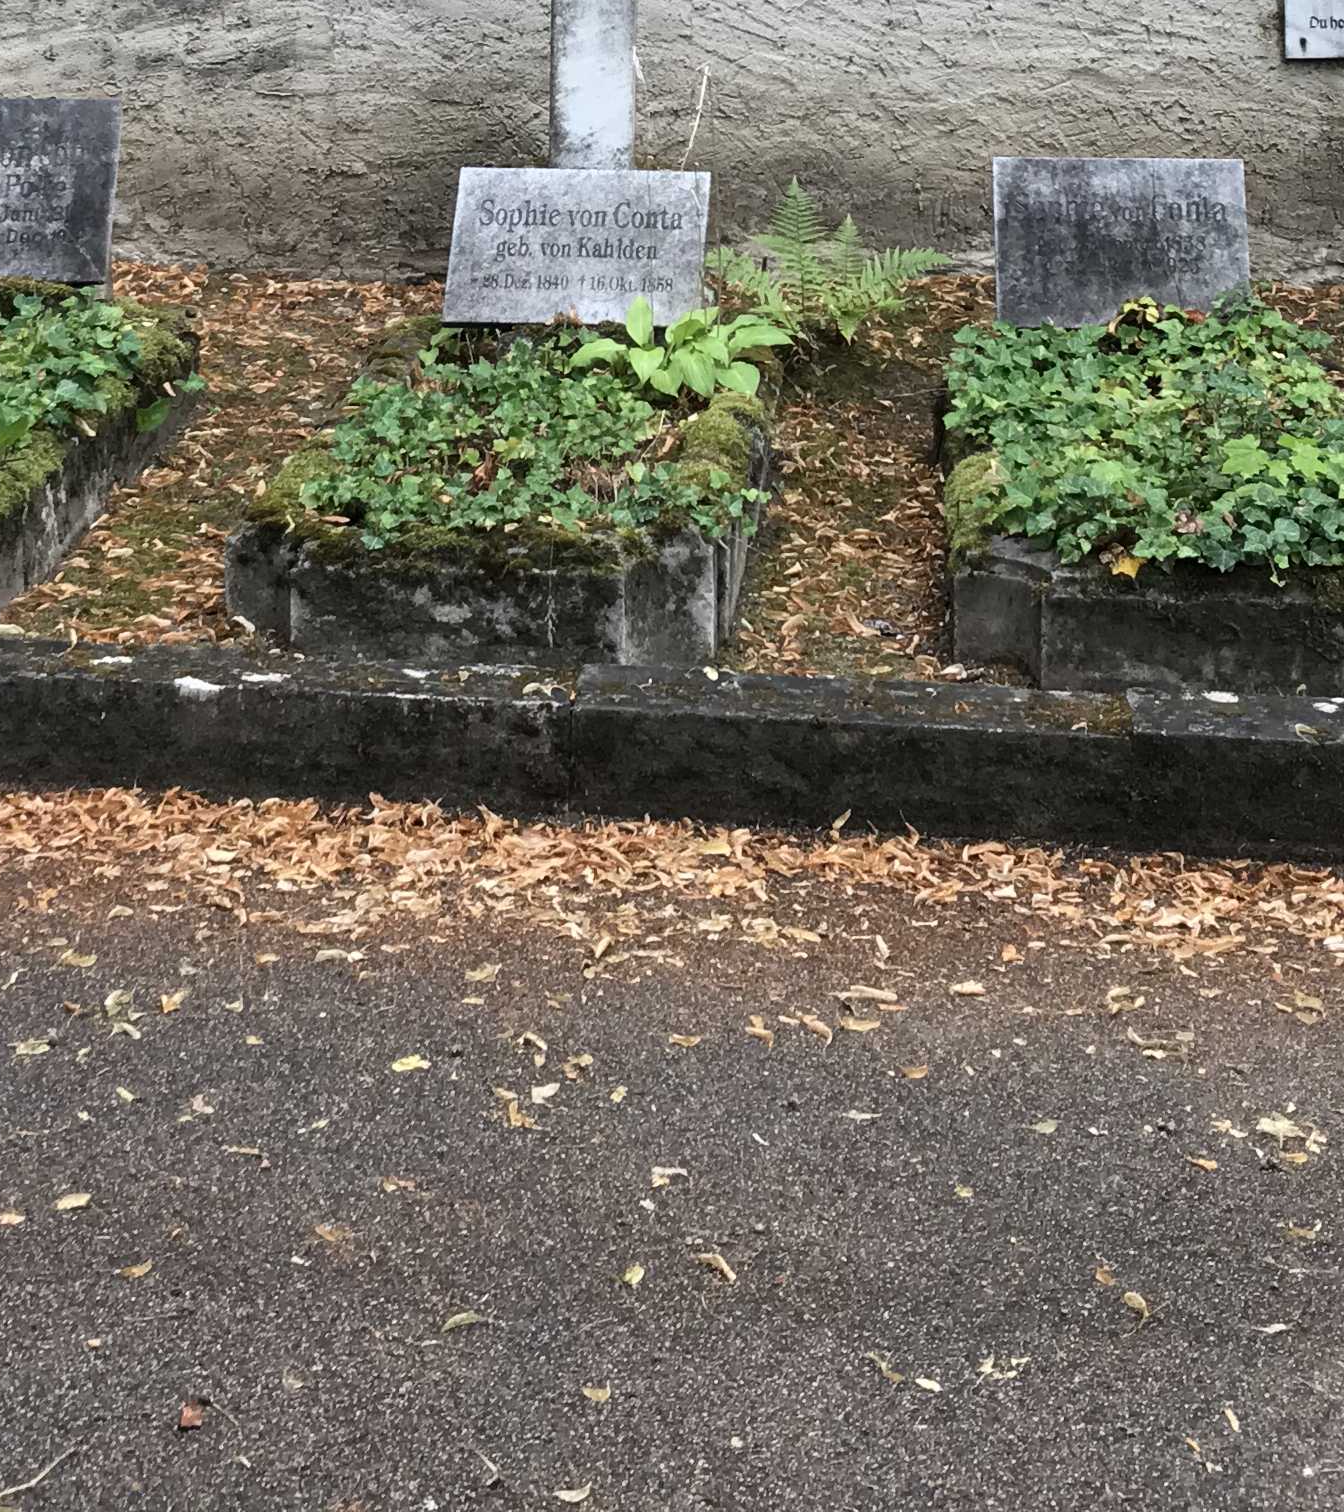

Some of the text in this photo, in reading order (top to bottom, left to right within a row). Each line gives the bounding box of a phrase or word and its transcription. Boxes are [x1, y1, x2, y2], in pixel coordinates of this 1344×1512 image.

[1309, 16, 1328, 29] Du
[479, 199, 683, 232] Sophie von Conta
[495, 235, 659, 263] geb. von Kahlden
